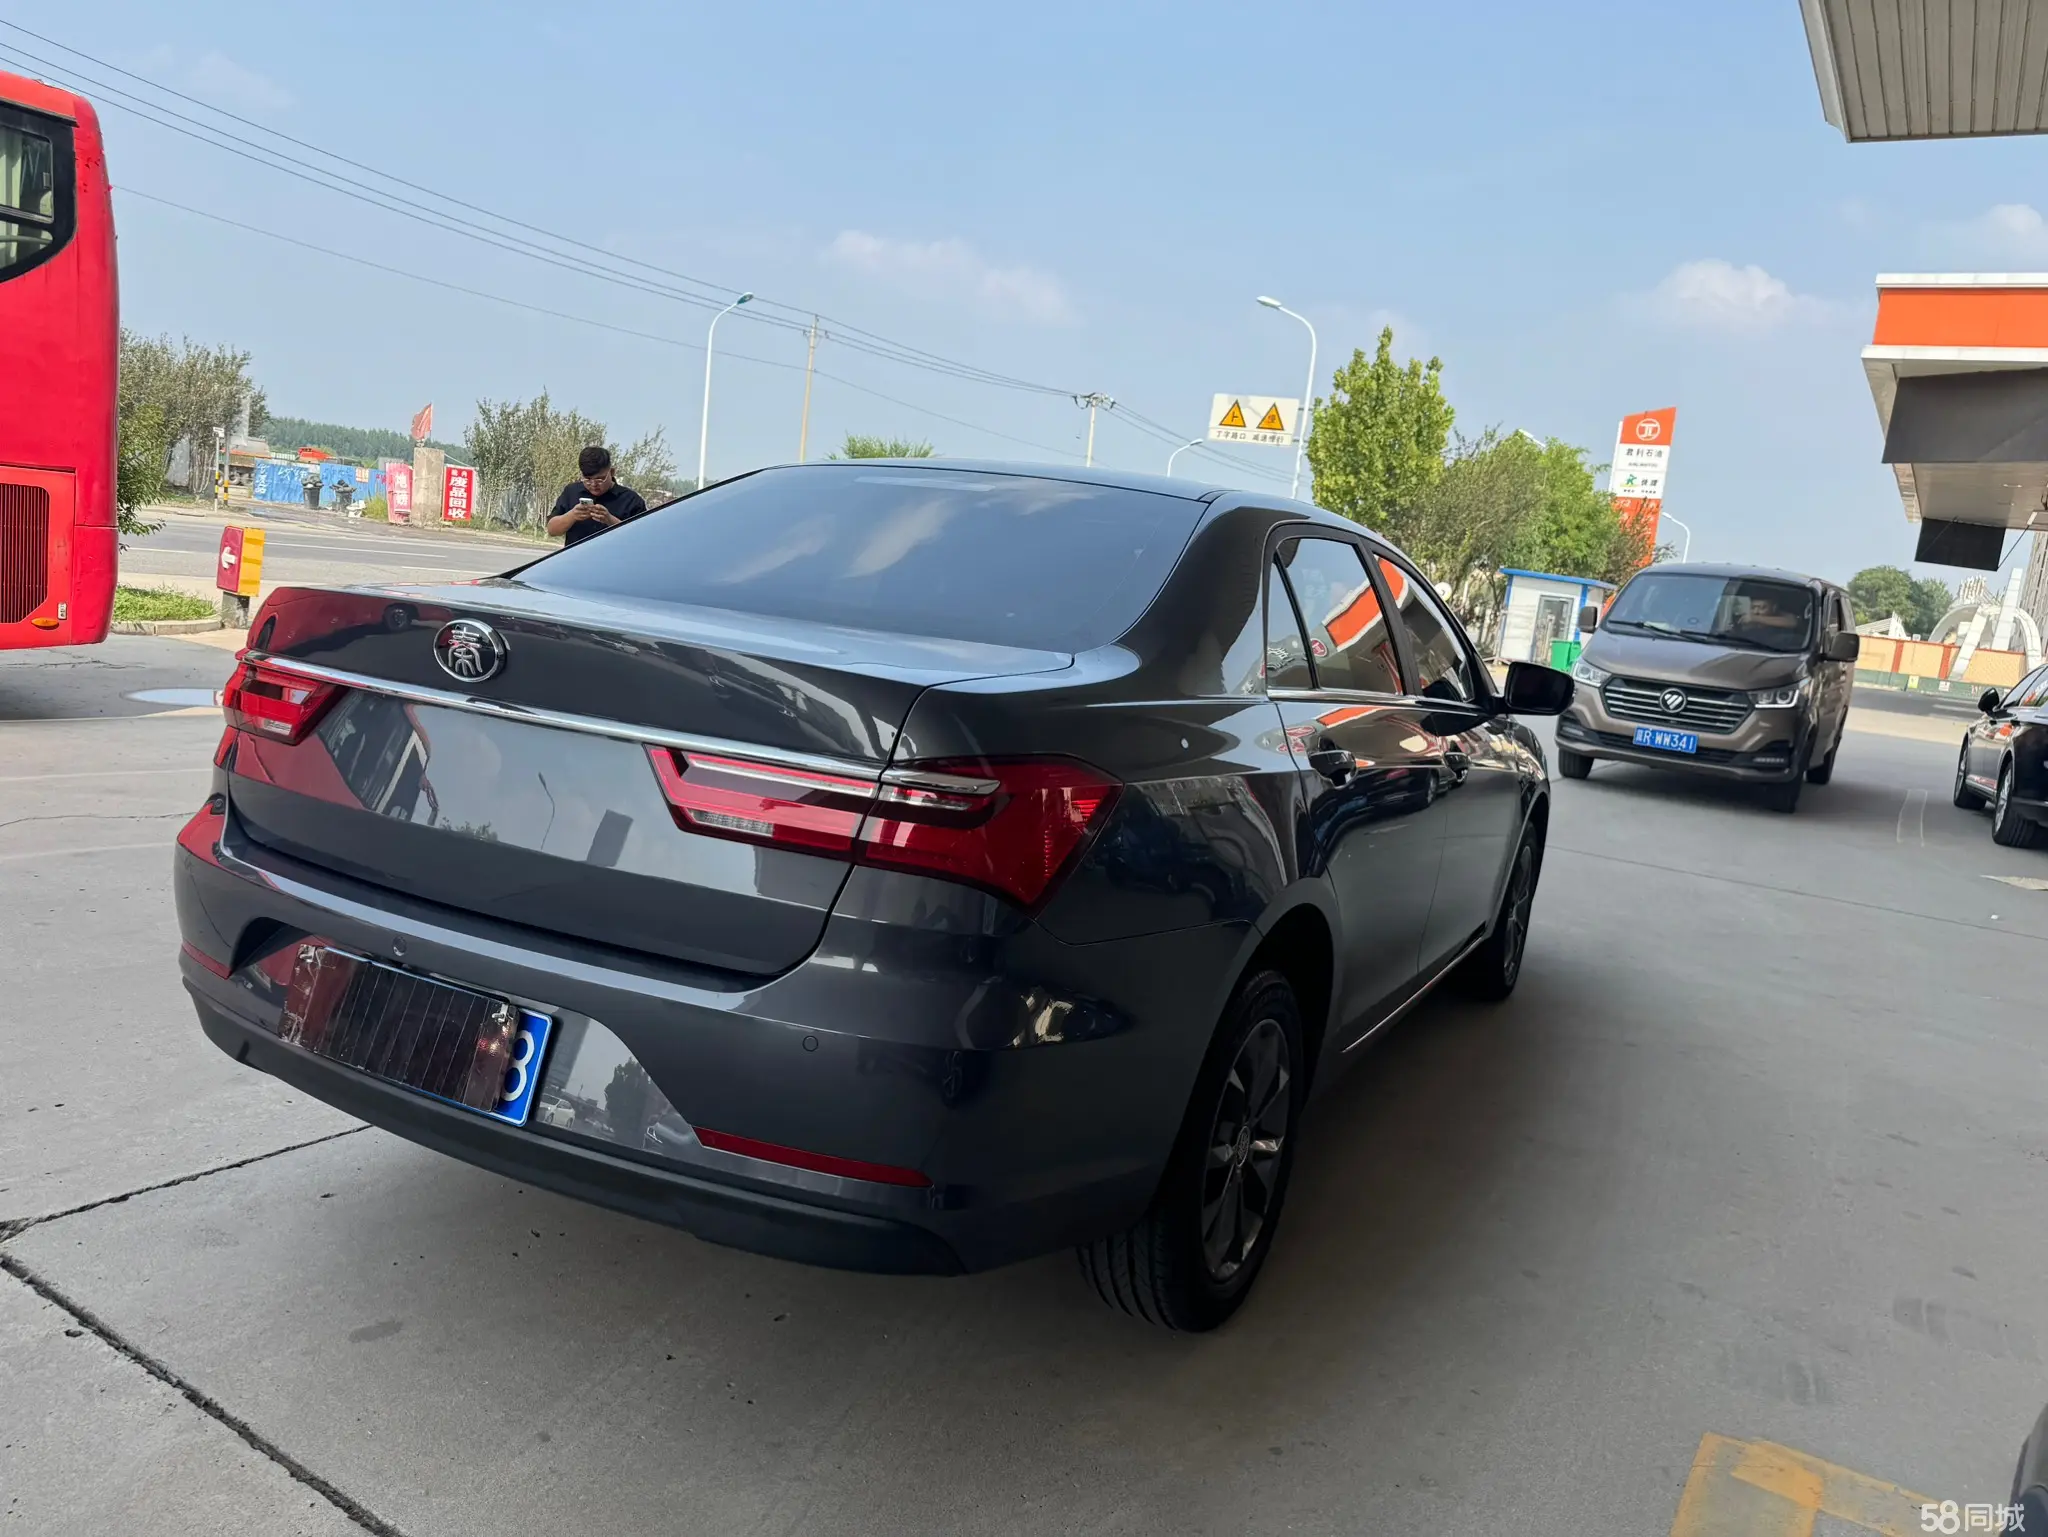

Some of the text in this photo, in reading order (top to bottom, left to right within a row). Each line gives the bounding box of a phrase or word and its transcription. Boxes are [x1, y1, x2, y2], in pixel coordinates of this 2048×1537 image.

[1216, 430, 1247, 440] 丁字路口
[447, 476, 468, 519] 废品回收
